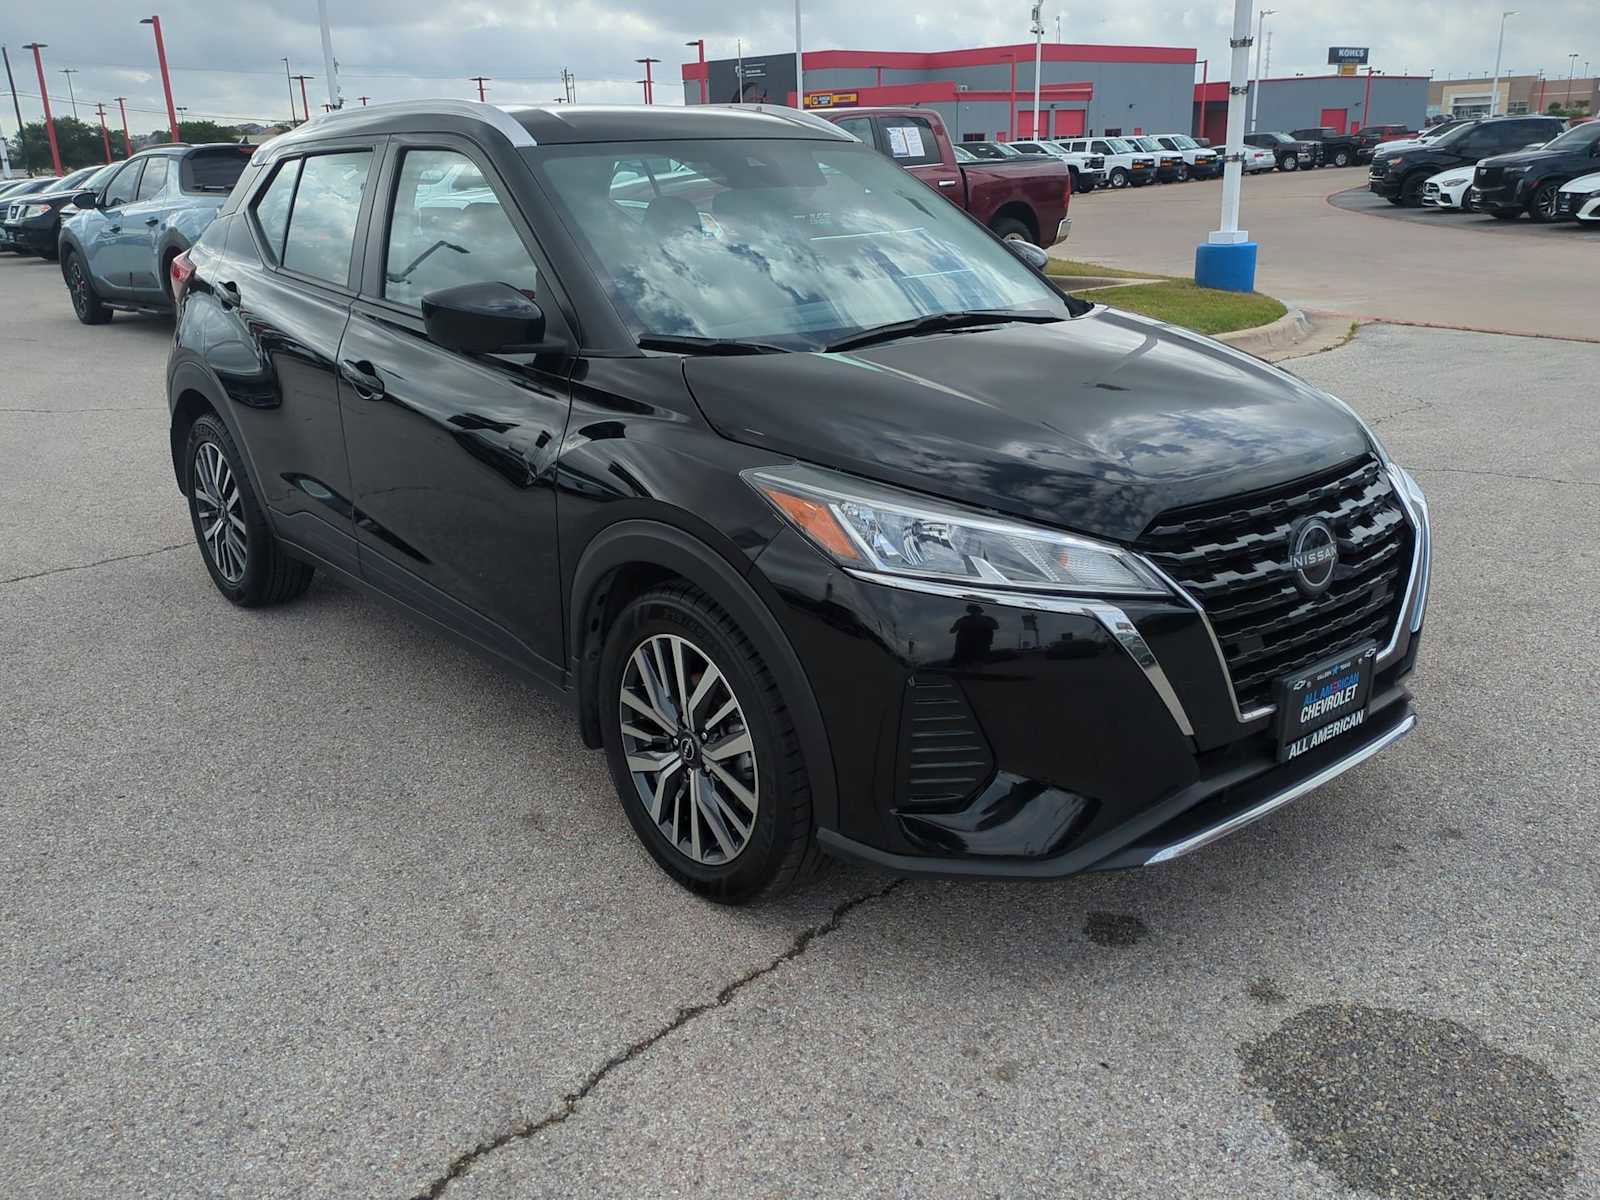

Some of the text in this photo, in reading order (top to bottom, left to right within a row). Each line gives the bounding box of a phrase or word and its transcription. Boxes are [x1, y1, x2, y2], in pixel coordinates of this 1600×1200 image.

[1293, 545, 1337, 568] NISSAN
[1300, 683, 1359, 723] CHEVROLET
[1303, 672, 1360, 705] ALL AMERICAN
[1288, 709, 1365, 760] ALL AMERICAN
